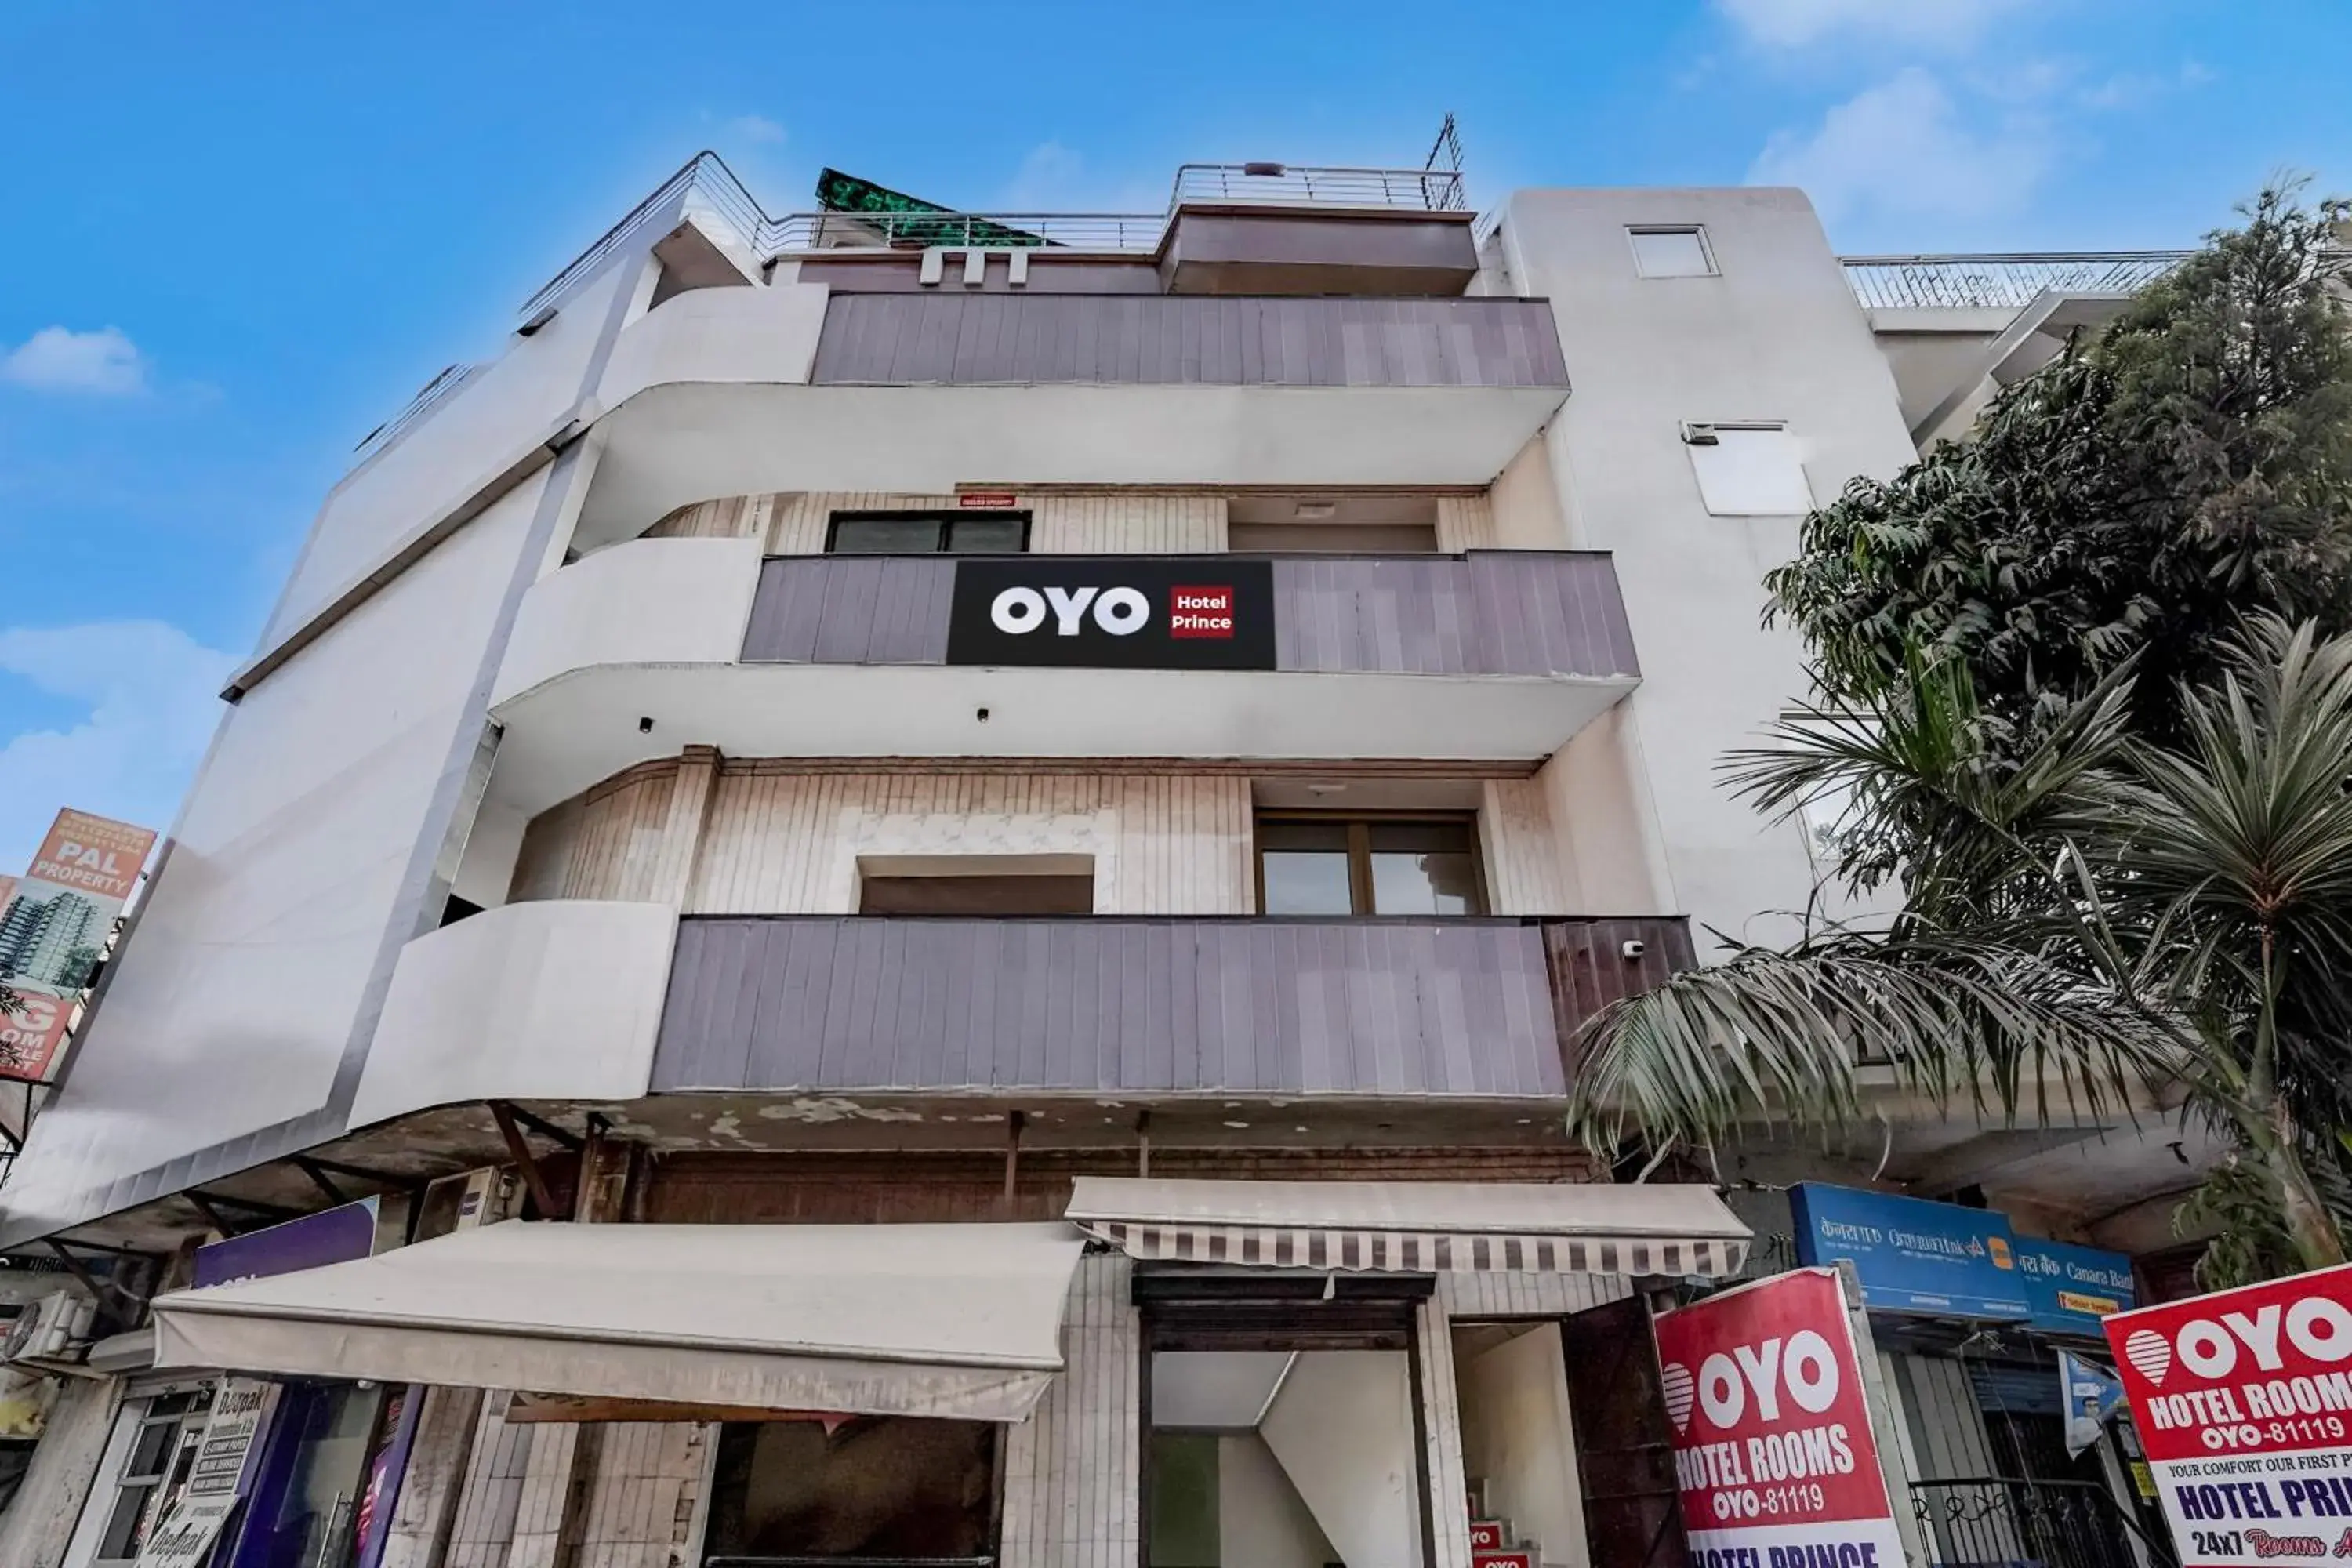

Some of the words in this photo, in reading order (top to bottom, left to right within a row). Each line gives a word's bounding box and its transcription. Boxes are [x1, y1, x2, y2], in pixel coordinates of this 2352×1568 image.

[991, 586, 1150, 636] OYO
[1177, 596, 1227, 610] Hotel
[1172, 615, 1232, 630] Prince
[34, 860, 128, 893] PROPERTY
[56, 840, 121, 877] PAL
[2066, 1261, 2109, 1285] Canara
[2176, 1296, 2352, 1380] OYO
[1699, 1330, 1839, 1428] OYO
[2147, 1386, 2245, 1431] HOTEL
[2243, 1371, 2352, 1419] ROOM
[2201, 1416, 2345, 1450] OYO-81119
[1675, 1440, 1748, 1491] HOTEL
[1747, 1423, 1855, 1483] ROOMS
[2168, 1464, 2201, 1478] YOUR
[2202, 1459, 2262, 1475] COMFORT
[2266, 1457, 2296, 1472] OUR
[2297, 1454, 2338, 1470] FIRST
[2340, 1453, 2352, 1468] P
[1713, 1483, 1825, 1520] OYO-81119
[2176, 1482, 2282, 1519] HOTEL
[2191, 1530, 2244, 1556] 24x7
[2243, 1528, 2328, 1559] Rooms
